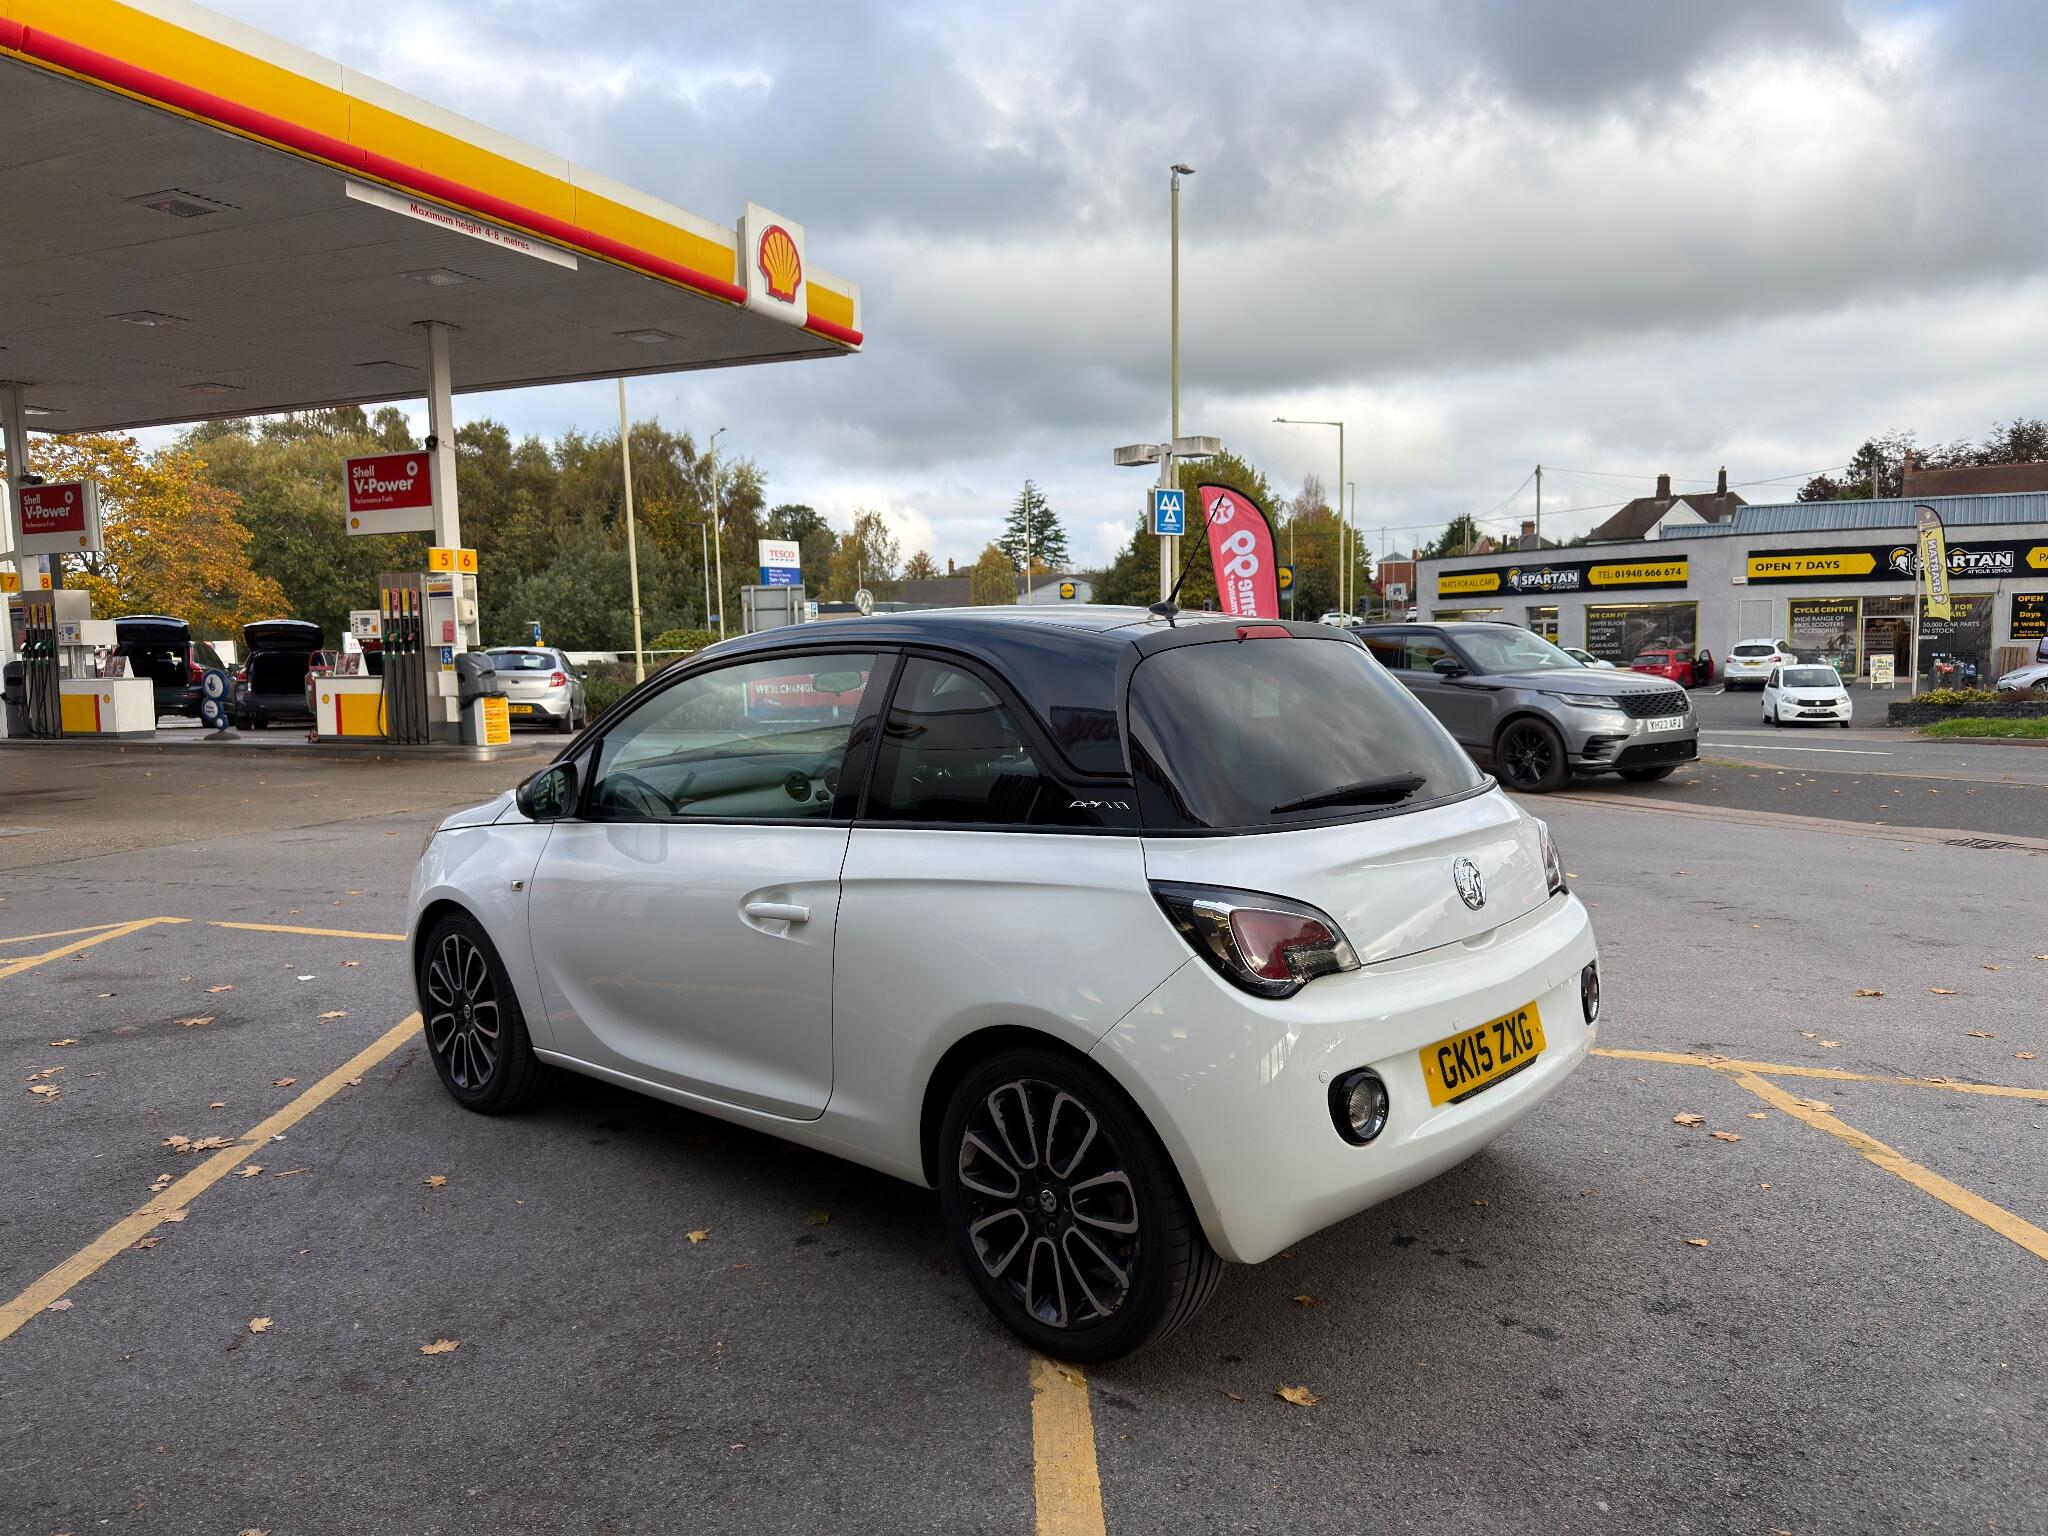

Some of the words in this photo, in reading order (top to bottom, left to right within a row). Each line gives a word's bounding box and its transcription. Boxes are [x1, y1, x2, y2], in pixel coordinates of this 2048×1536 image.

[410, 203, 453, 225] Maximum
[455, 218, 482, 235] height
[503, 235, 530, 250] metres
[353, 465, 375, 478] Shell
[354, 478, 414, 495] V-Power
[24, 494, 40, 505] Shell
[25, 505, 70, 519] V-Power
[441, 553, 449, 566] 5
[463, 553, 471, 567] 6
[769, 550, 795, 558] TESCO
[1755, 562, 1791, 572] OPEN
[1795, 562, 1802, 570] 7
[1806, 560, 1840, 570] DAYS
[1615, 569, 1642, 578] 01948
[1645, 568, 1661, 576] 666
[1664, 567, 1682, 576] 674
[7, 576, 16, 588] 7
[41, 577, 50, 589] 8
[1457, 580, 1469, 588] FOR
[1469, 579, 1479, 587] ALL
[1480, 578, 1495, 586] CARS
[1521, 572, 1578, 586] SPARTAN
[1650, 720, 1669, 730] YH22
[1669, 718, 1681, 729] AFJ
[1437, 1030, 1494, 1089] GK15
[1492, 1012, 1534, 1064] ZXG
